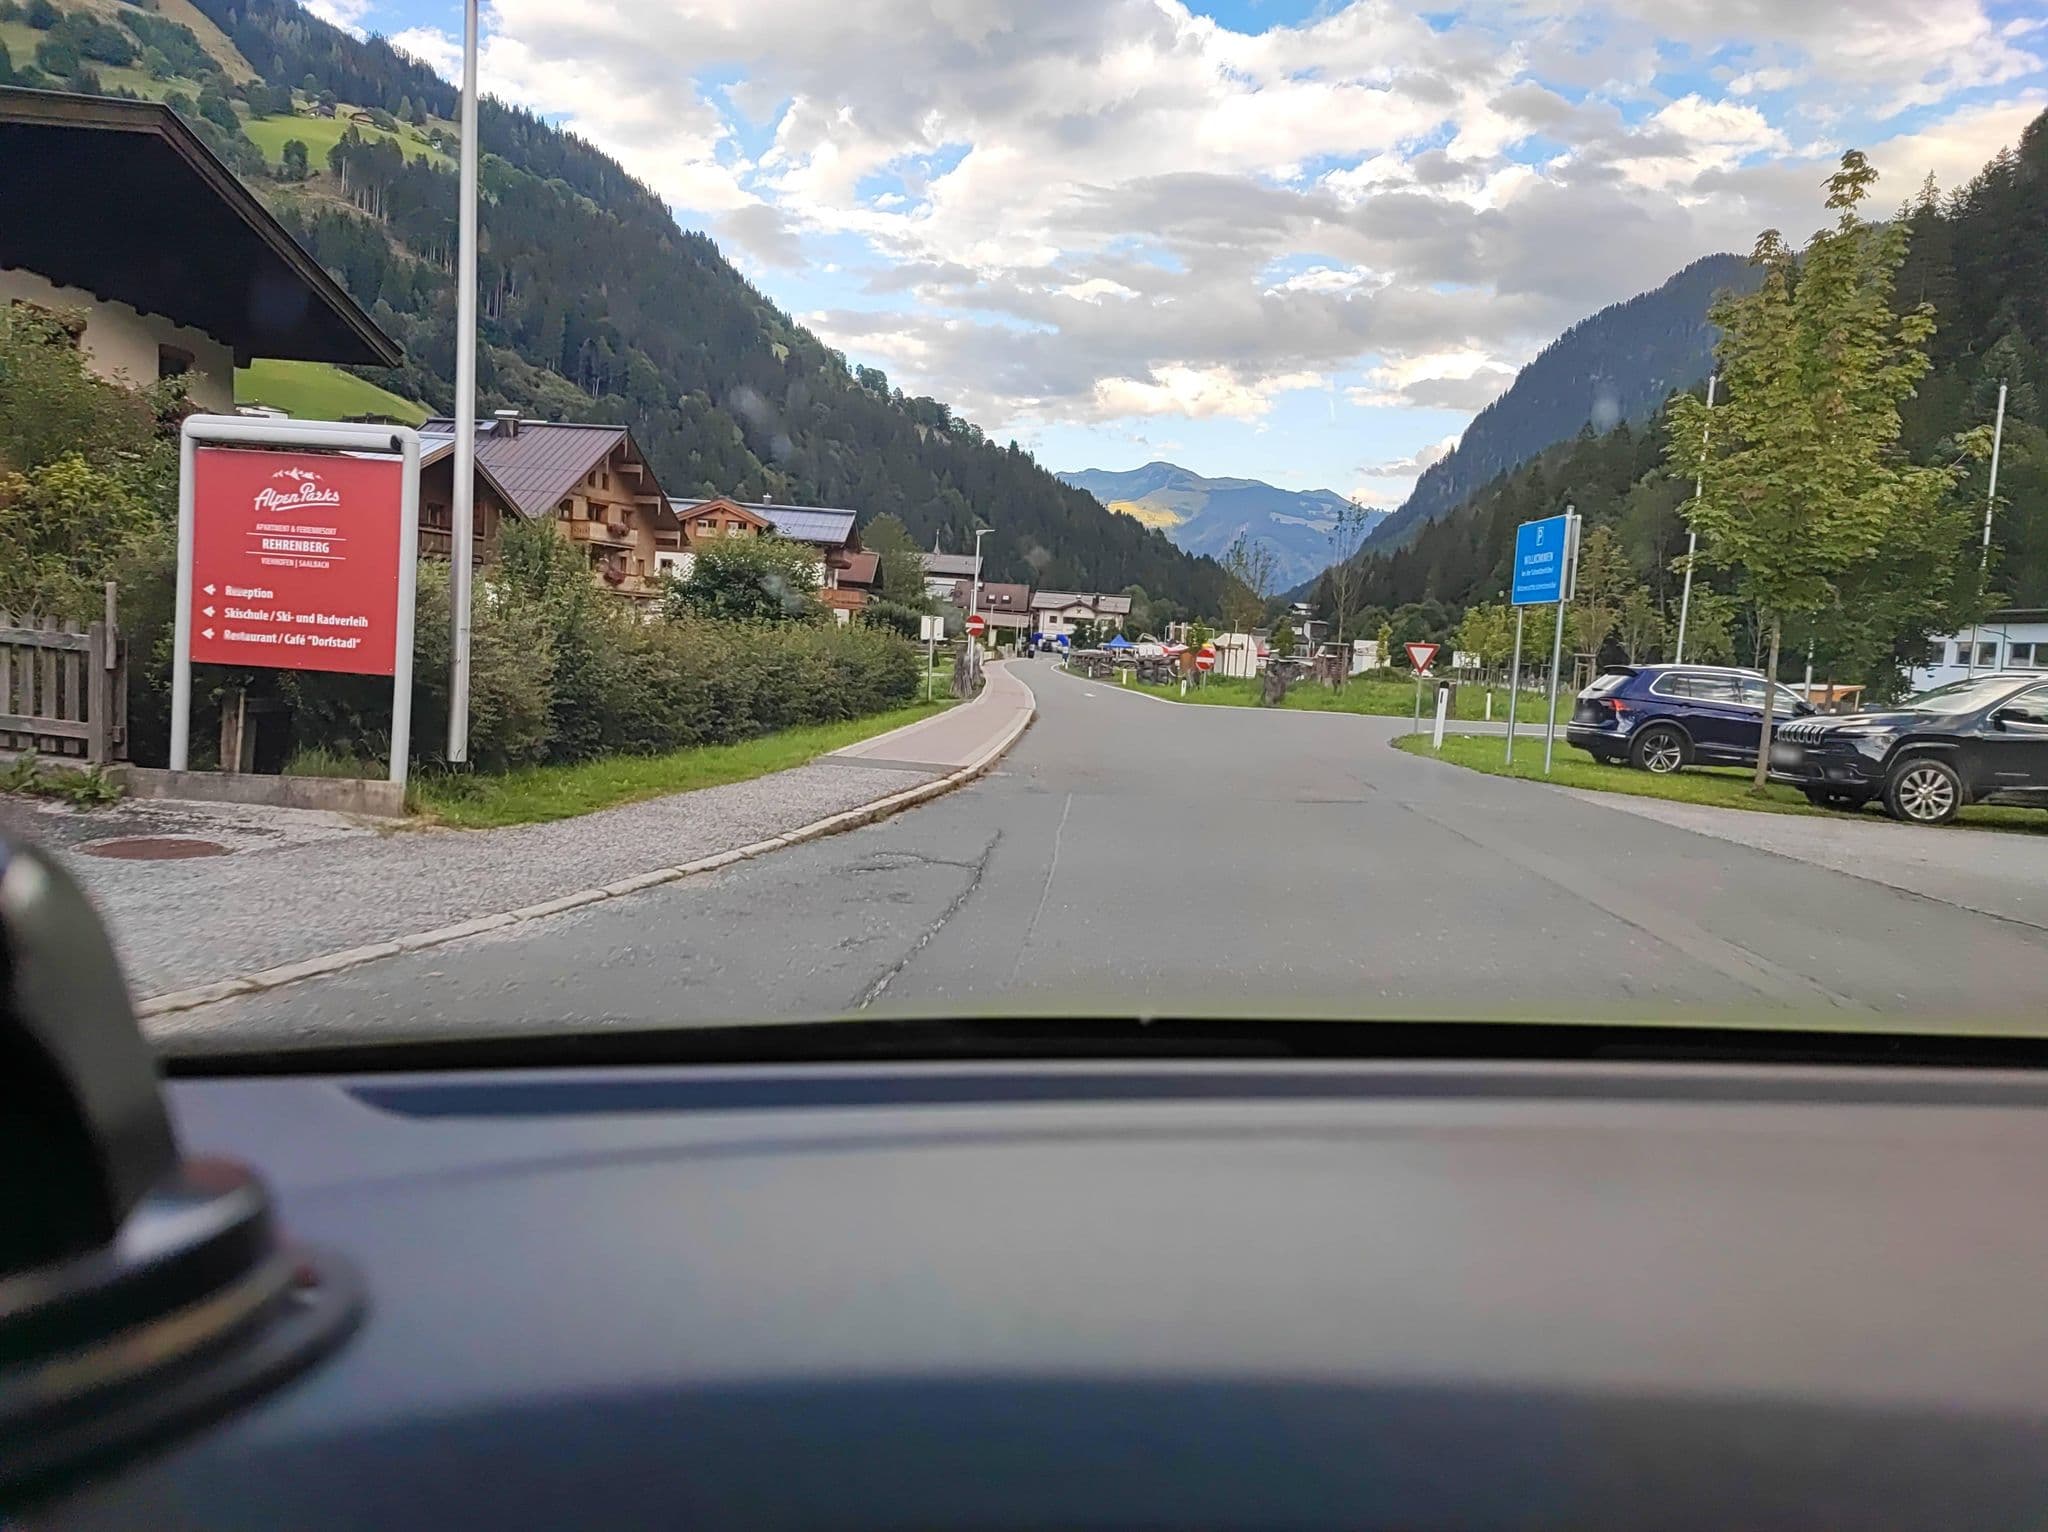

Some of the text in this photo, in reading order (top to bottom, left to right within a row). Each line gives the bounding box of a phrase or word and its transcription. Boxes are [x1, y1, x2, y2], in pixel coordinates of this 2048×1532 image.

[262, 538, 330, 554] REHRENBERG
[224, 607, 270, 621] Skischule
[276, 610, 295, 622] Ski-
[296, 613, 316, 624] und
[316, 614, 369, 628] Radverleih
[284, 633, 306, 646] Café
